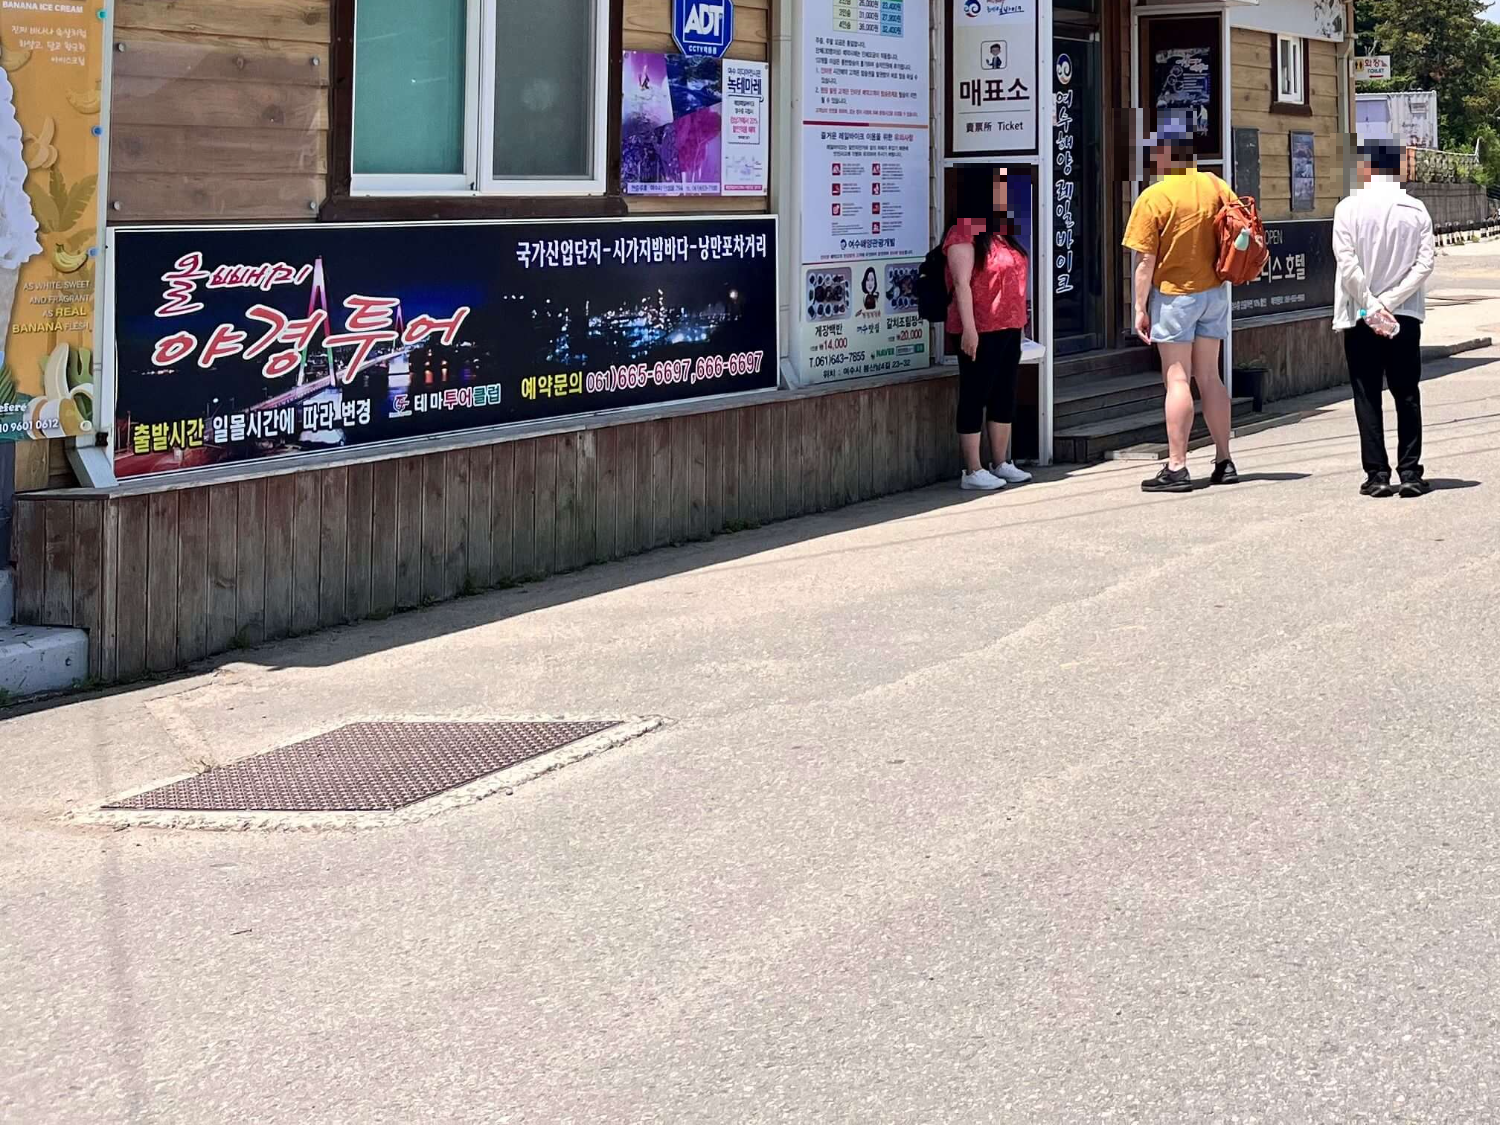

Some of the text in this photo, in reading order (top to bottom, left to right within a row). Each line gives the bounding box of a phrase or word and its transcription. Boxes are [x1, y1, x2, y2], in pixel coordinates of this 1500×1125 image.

[2, 1, 83, 13] BANANA ICE CREAM
[684, 3, 723, 37] ADT
[727, 76, 762, 95] 녹테마레
[959, 78, 1031, 108] 매표소
[997, 121, 1024, 132] Ticket
[1055, 89, 1075, 295] 여수해양 레일바이크
[1264, 229, 1283, 245] OPEN
[1284, 253, 1306, 281] 호텔
[63, 280, 90, 289] SWEET
[55, 307, 87, 317] REAL
[12, 322, 63, 334] BANANA
[151, 294, 471, 385] 야경투어
[521, 371, 583, 400] 예약문의
[10, 422, 33, 432] 9601
[36, 419, 59, 430] 0612
[133, 398, 372, 455] 출발시간 일몰시간에 따라 변경
